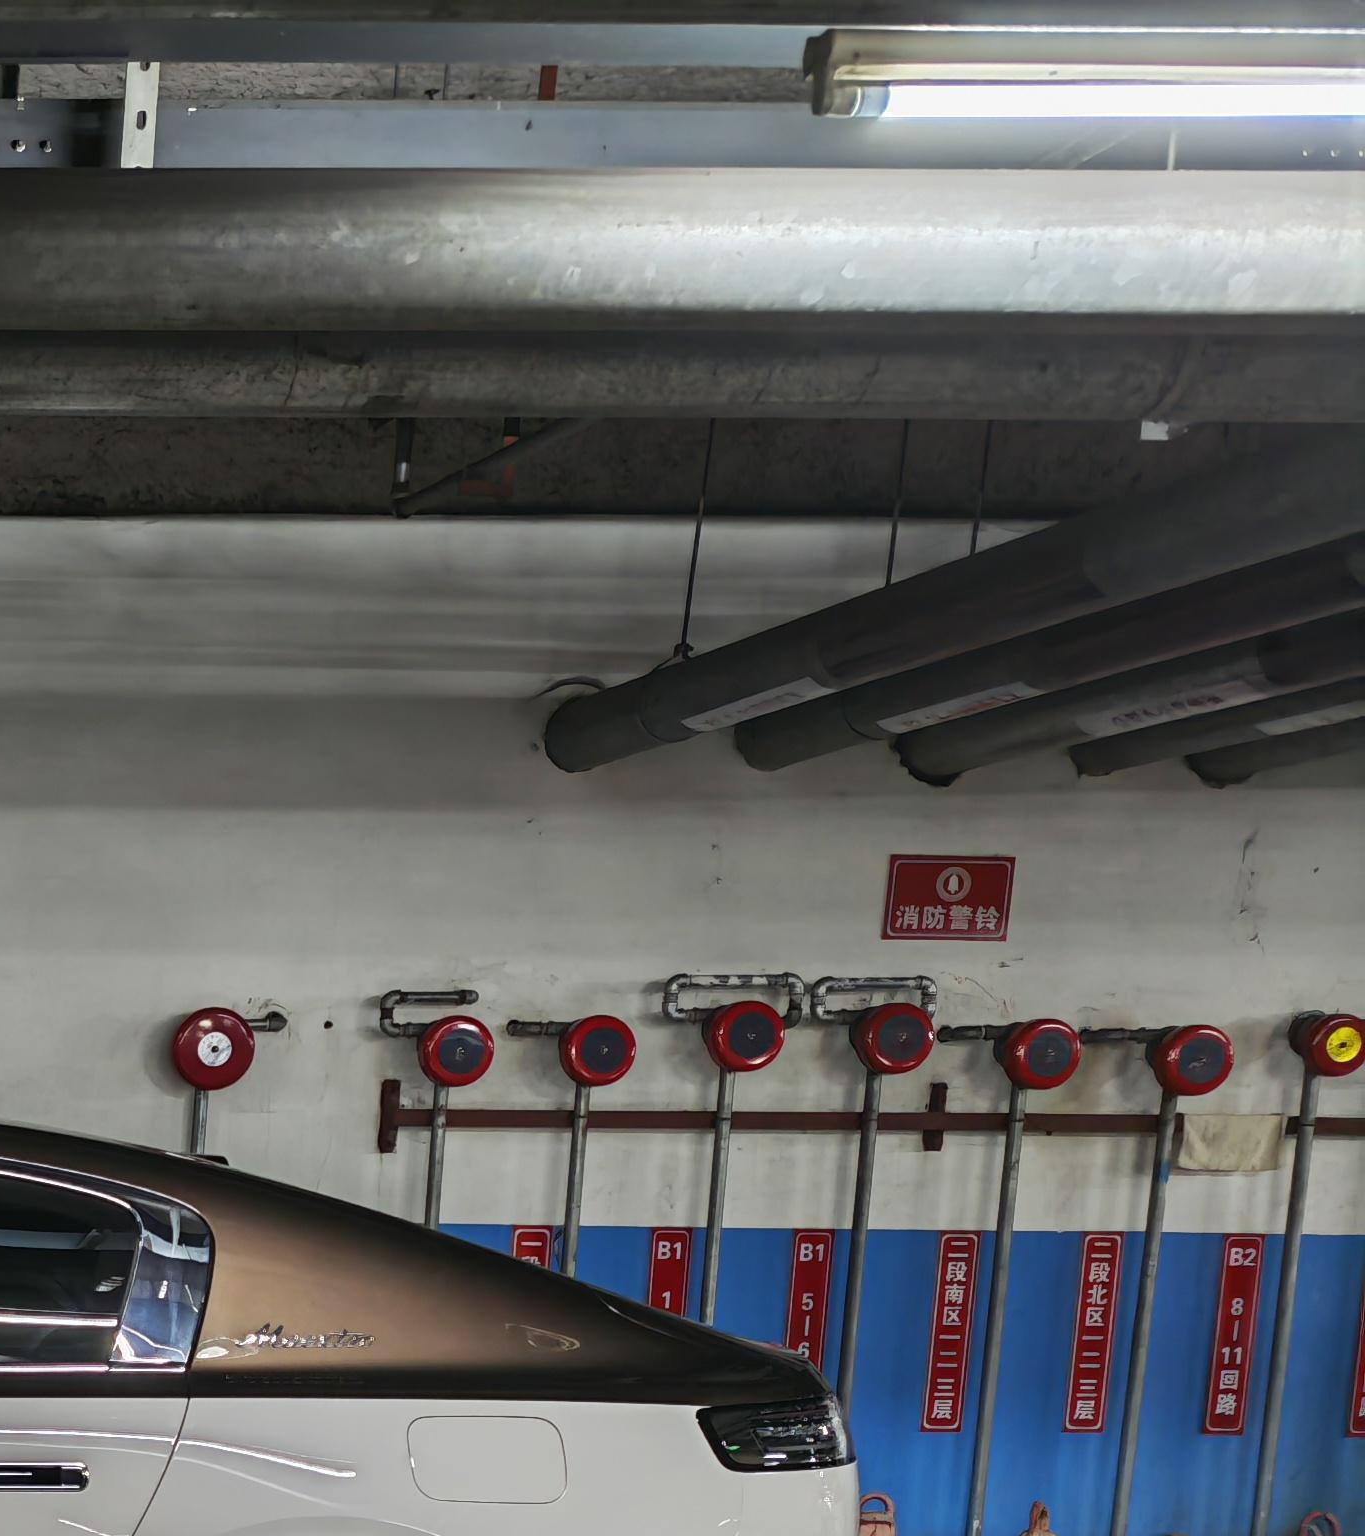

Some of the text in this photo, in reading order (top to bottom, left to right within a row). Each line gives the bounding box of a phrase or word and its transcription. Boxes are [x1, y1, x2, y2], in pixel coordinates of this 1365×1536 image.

[895, 904, 1000, 930] 消防警铃
[657, 1241, 682, 1260] B1
[799, 1243, 825, 1262] B1
[1228, 1247, 1256, 1267] B2
[931, 1241, 969, 1419] 二段南区一二三层
[1073, 1241, 1113, 1420] 二段北区一二三层
